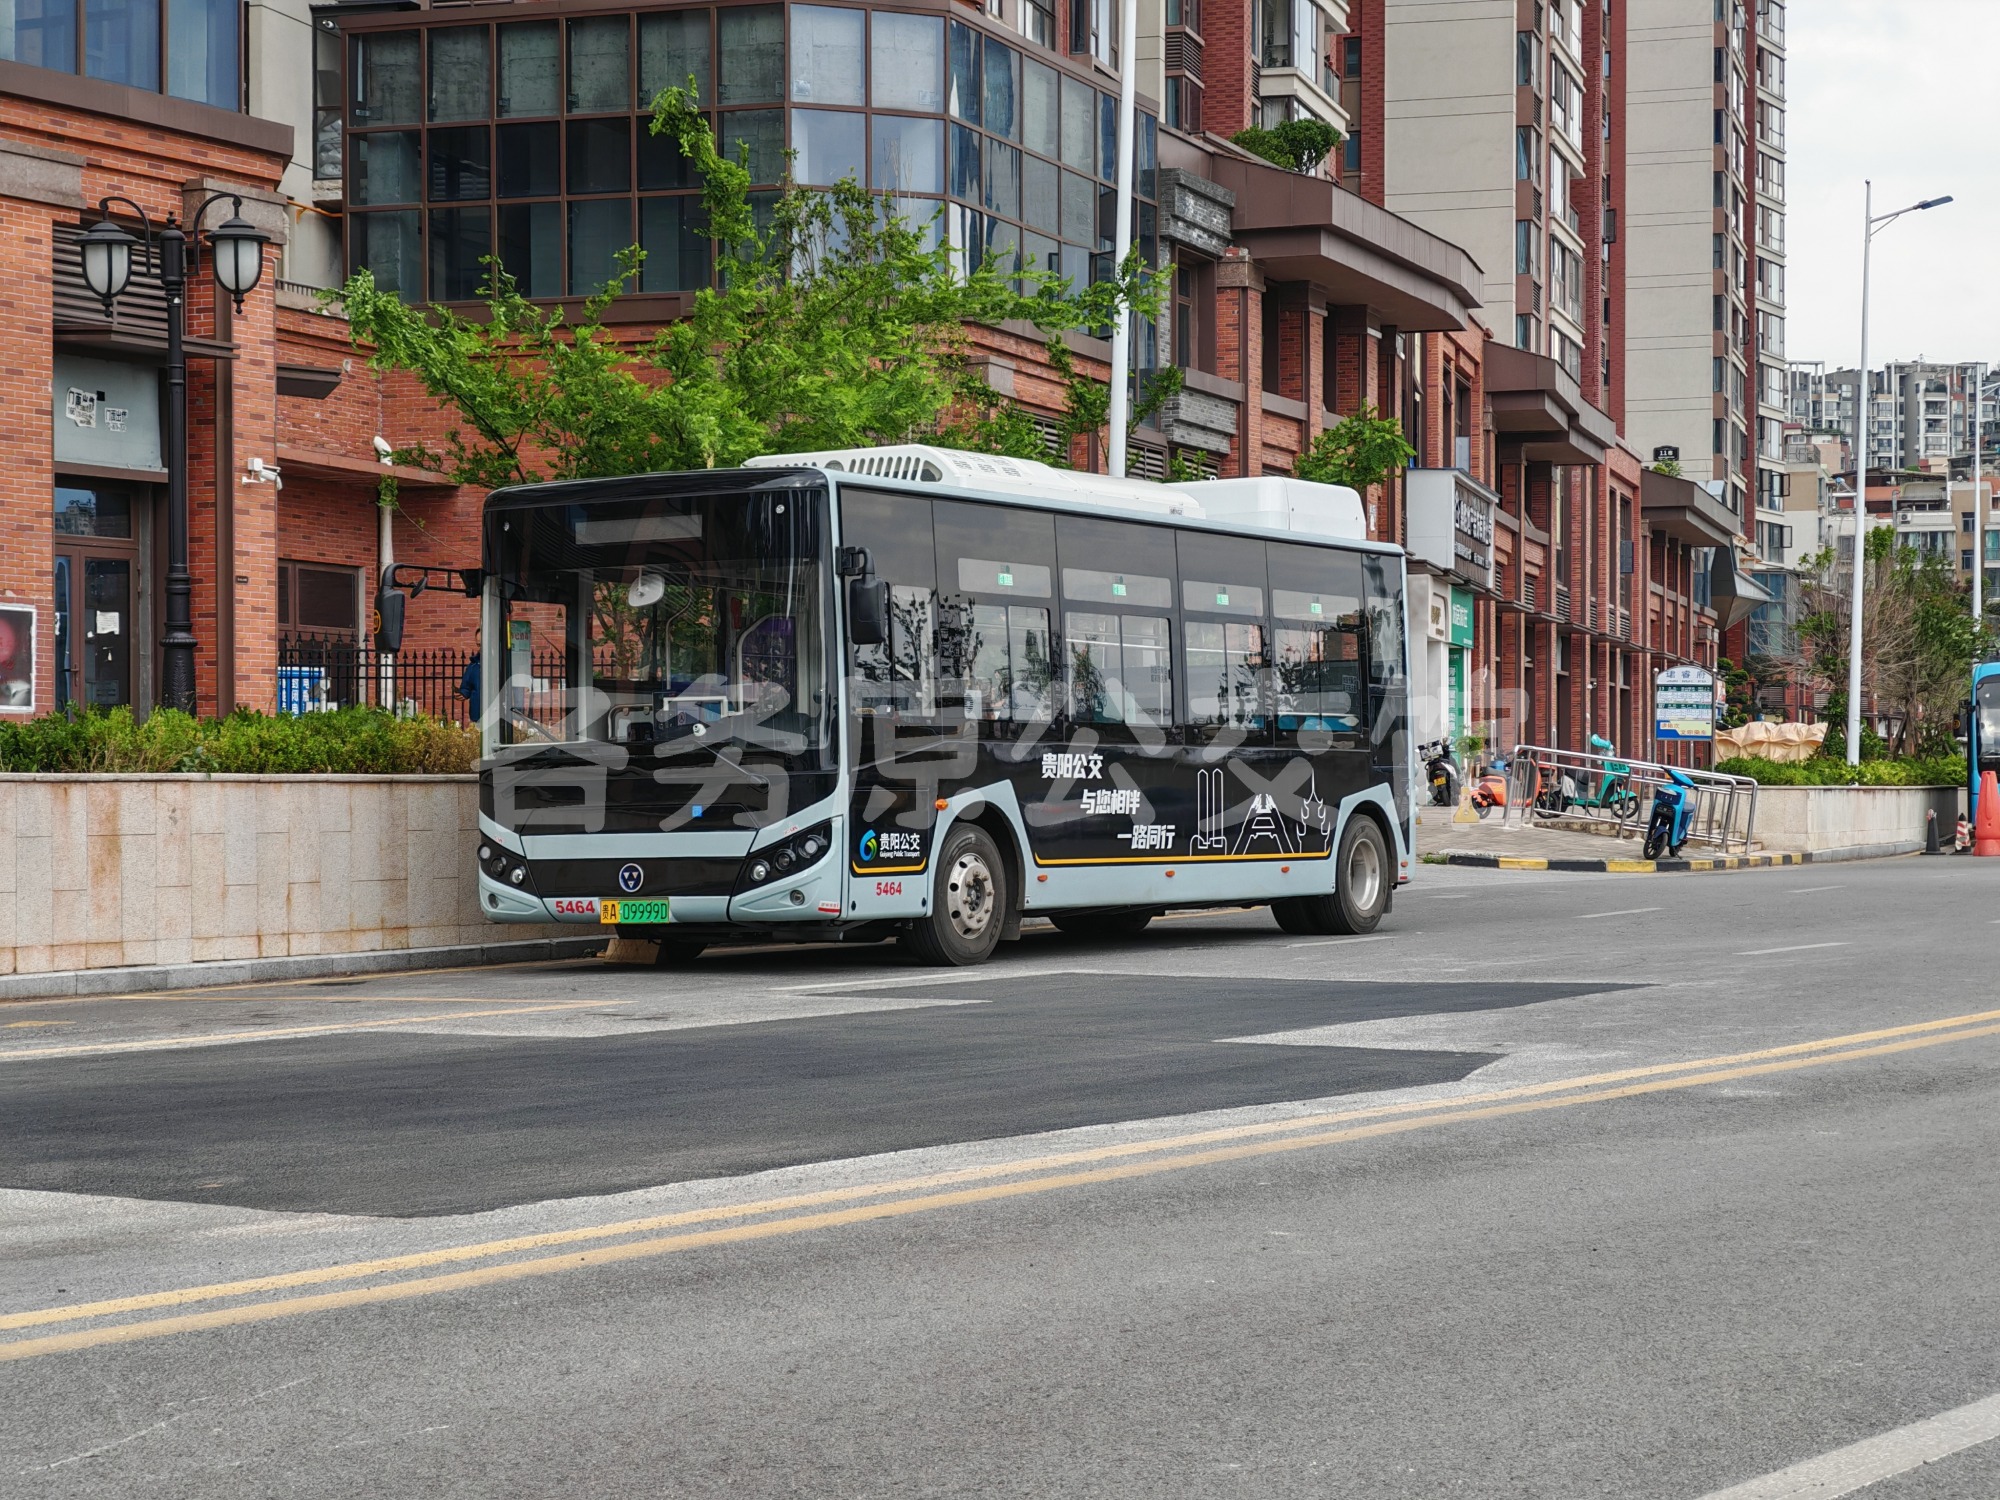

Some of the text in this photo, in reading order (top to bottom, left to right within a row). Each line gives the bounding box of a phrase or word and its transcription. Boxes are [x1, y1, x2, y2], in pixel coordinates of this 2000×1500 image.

[1041, 752, 1104, 779] 贵阳公交
[1080, 789, 1141, 815] 与您相伴
[879, 832, 920, 850] 贵阳公交
[1117, 824, 1176, 849] 一路同行
[876, 881, 902, 896] 5464
[555, 900, 596, 914] 5464
